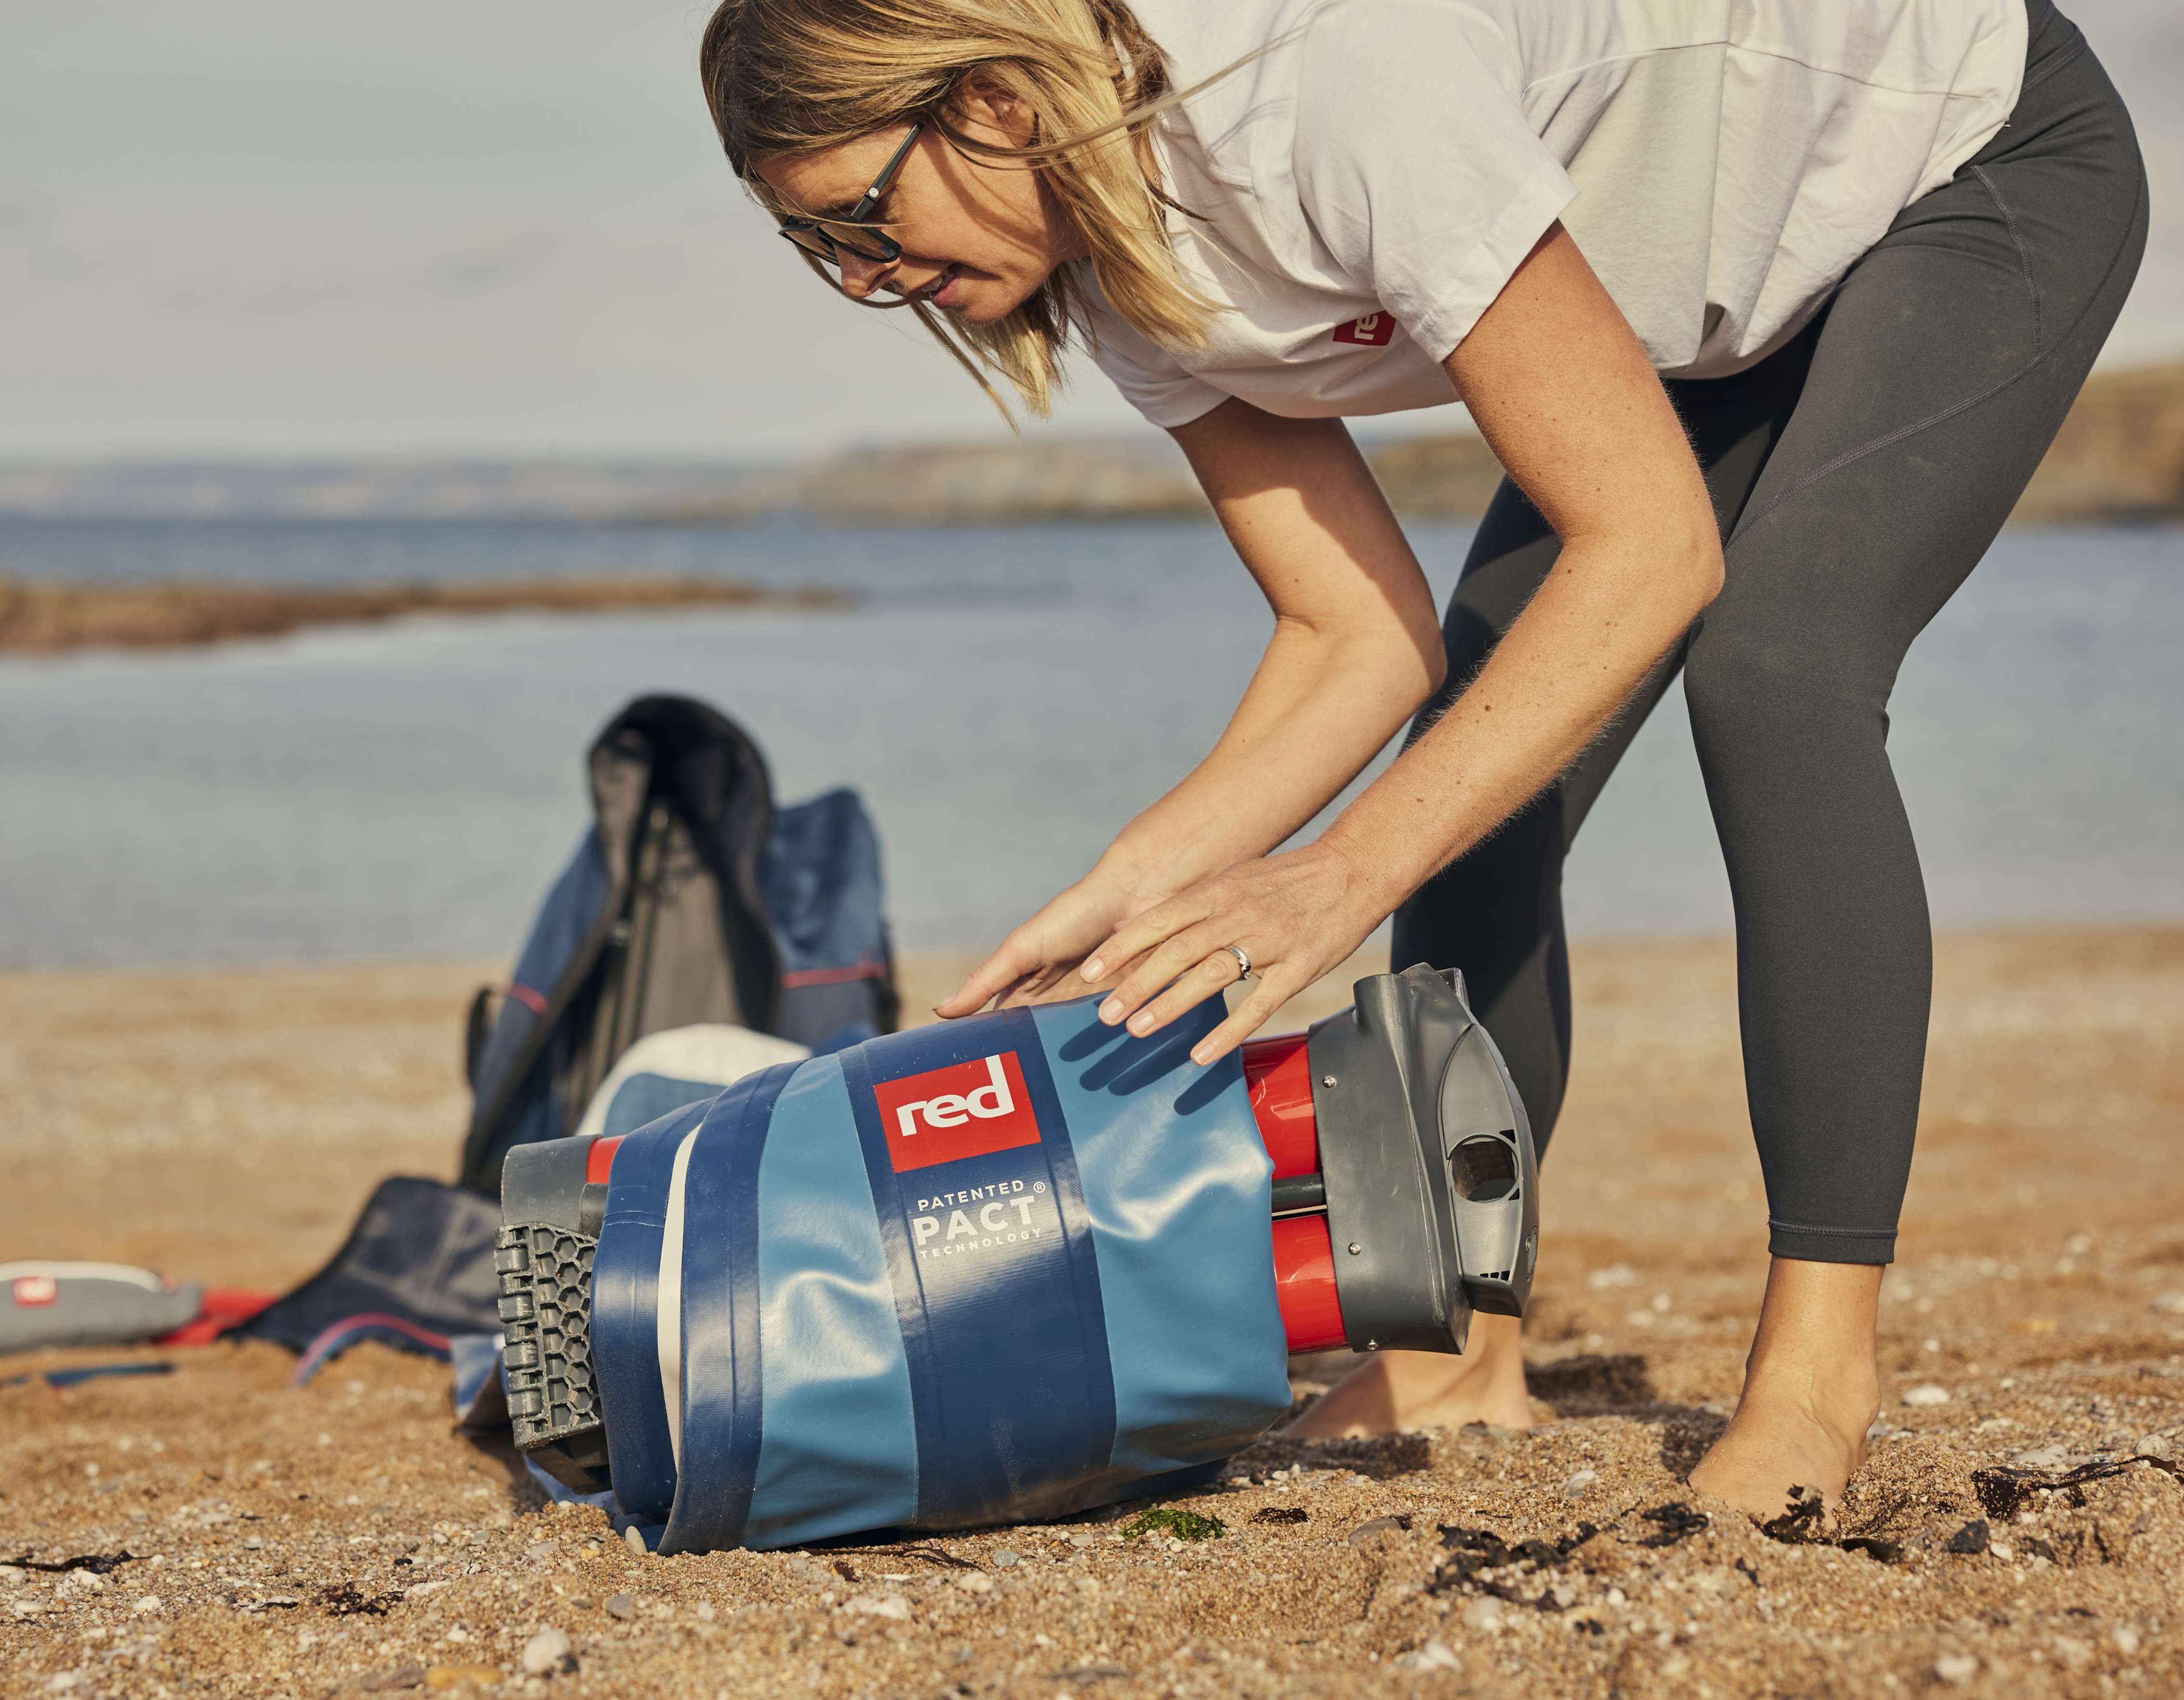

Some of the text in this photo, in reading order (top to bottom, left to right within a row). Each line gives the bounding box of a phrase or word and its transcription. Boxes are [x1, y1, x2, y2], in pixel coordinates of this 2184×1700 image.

[1354, 315, 1379, 341] re
[896, 1054, 1015, 1136] red
[918, 1180, 1024, 1211] PATENTED
[912, 1195, 1035, 1245] PACT
[920, 1228, 1041, 1259] TECHNOLOGY
